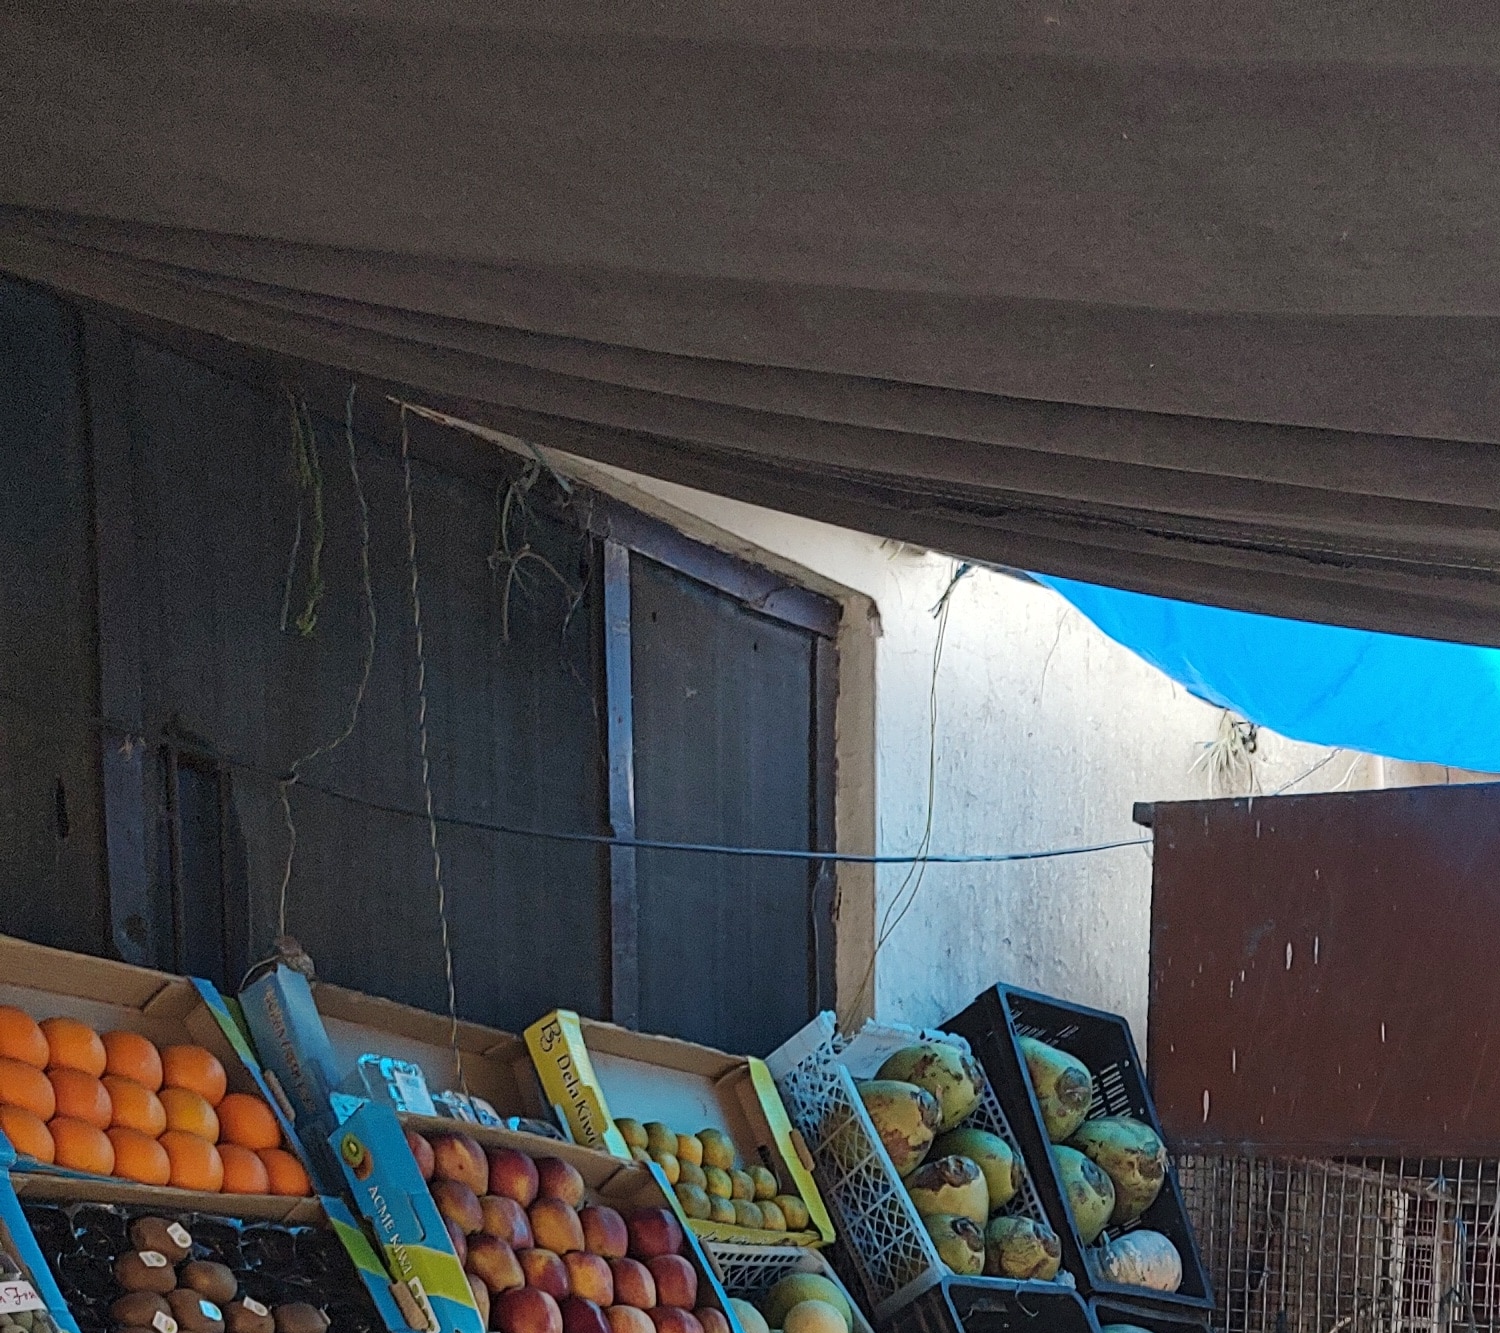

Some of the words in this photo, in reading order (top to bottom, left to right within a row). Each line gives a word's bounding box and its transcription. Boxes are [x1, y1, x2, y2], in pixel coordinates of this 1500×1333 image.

[556, 1054, 580, 1099] Dela
[575, 1099, 596, 1144] Kiwi
[367, 1185, 395, 1234] ACME
[389, 1233, 413, 1275] KIWI
